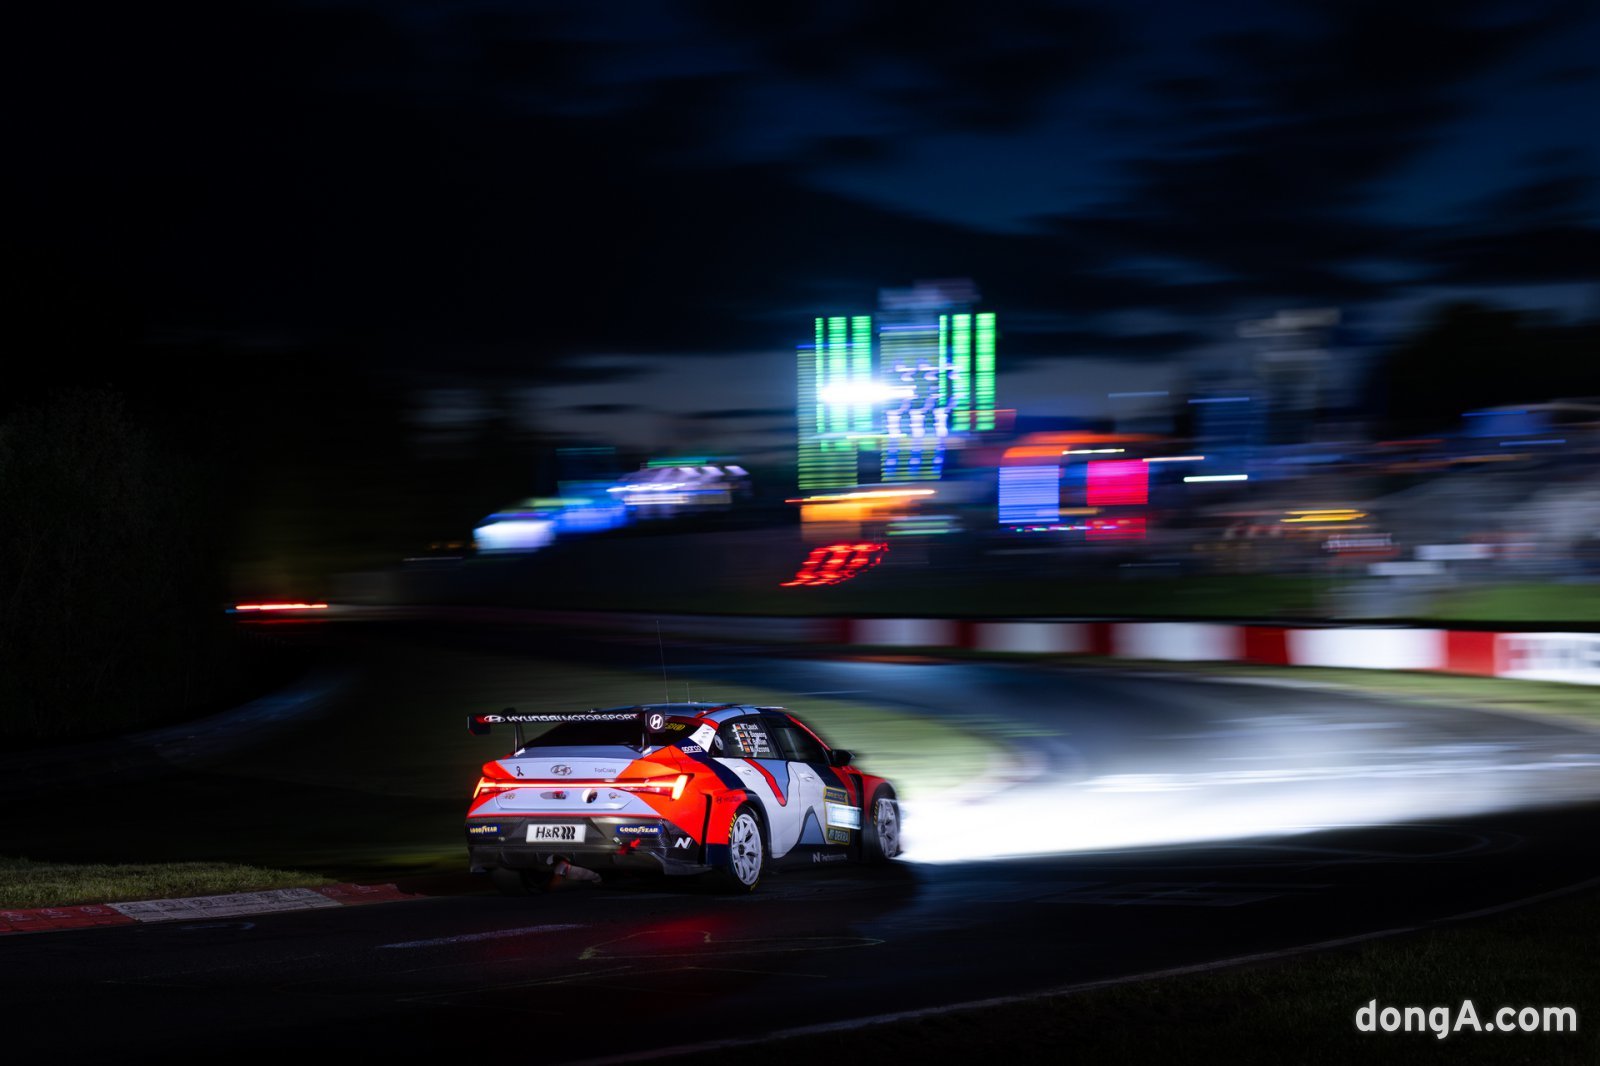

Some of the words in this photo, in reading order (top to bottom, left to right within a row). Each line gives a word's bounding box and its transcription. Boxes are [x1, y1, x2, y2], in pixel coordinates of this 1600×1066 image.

[563, 713, 638, 722] MOTORSPORT
[681, 745, 702, 754] sparco
[535, 826, 560, 839] H&R
[619, 825, 659, 834] GOODYEAR
